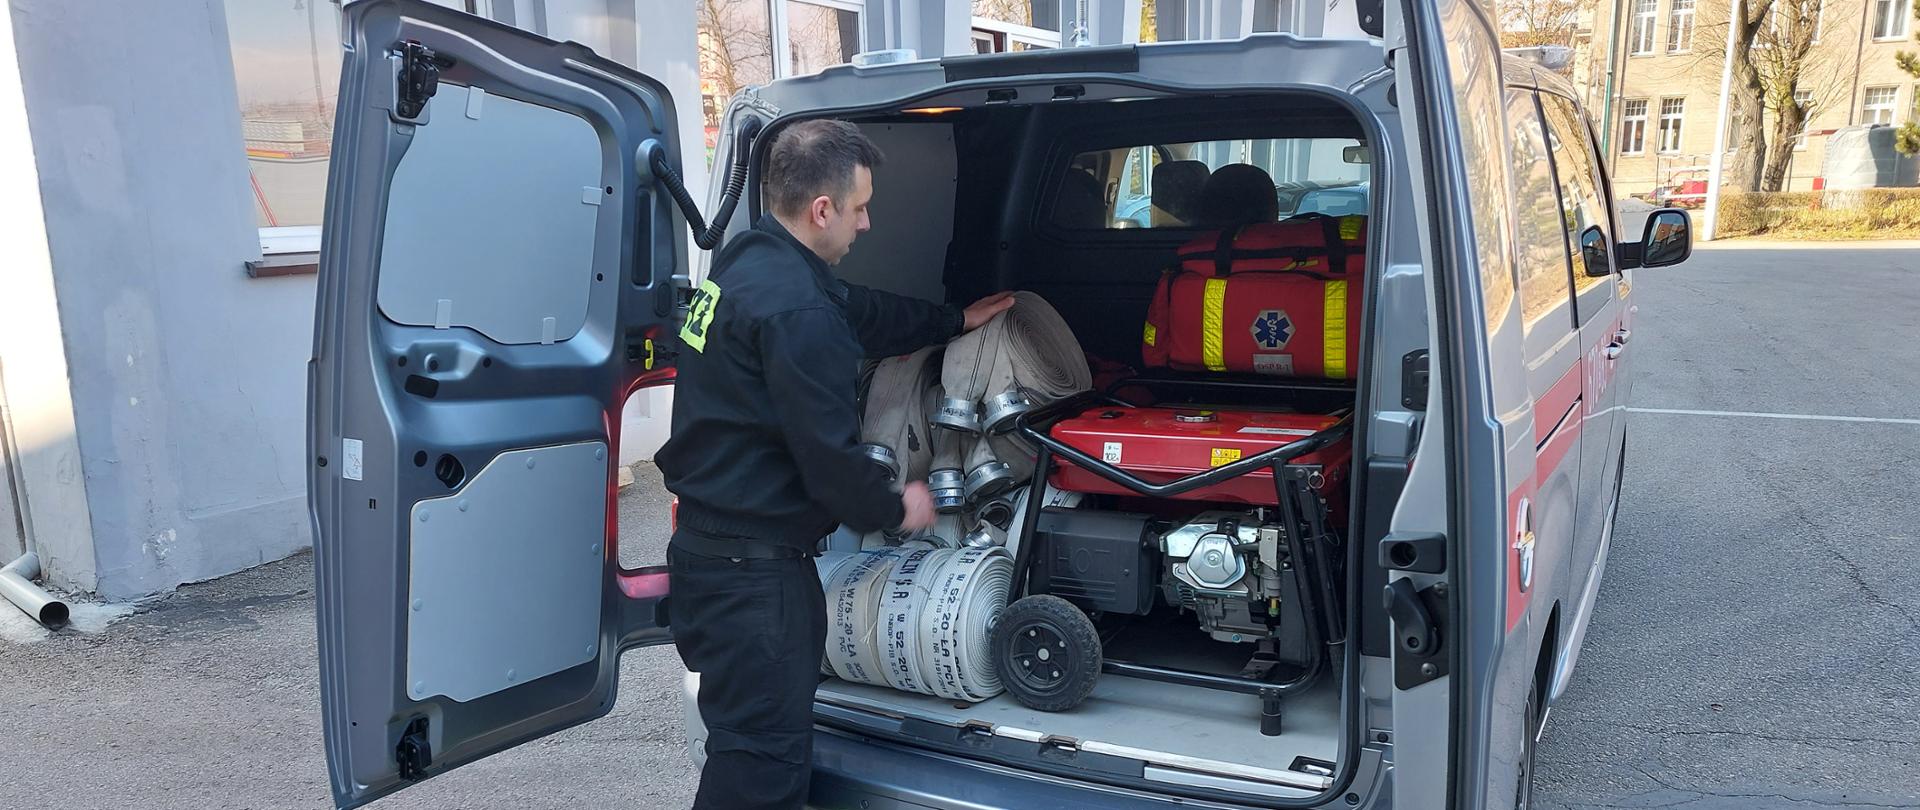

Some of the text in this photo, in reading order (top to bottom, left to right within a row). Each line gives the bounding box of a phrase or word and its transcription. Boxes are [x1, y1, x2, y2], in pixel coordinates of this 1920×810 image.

[1057, 545, 1111, 575] HOT
[845, 599, 853, 613] 75
[845, 623, 853, 636] 20
[940, 588, 960, 657] 52-20-ŁA
[943, 664, 956, 688] PCV
